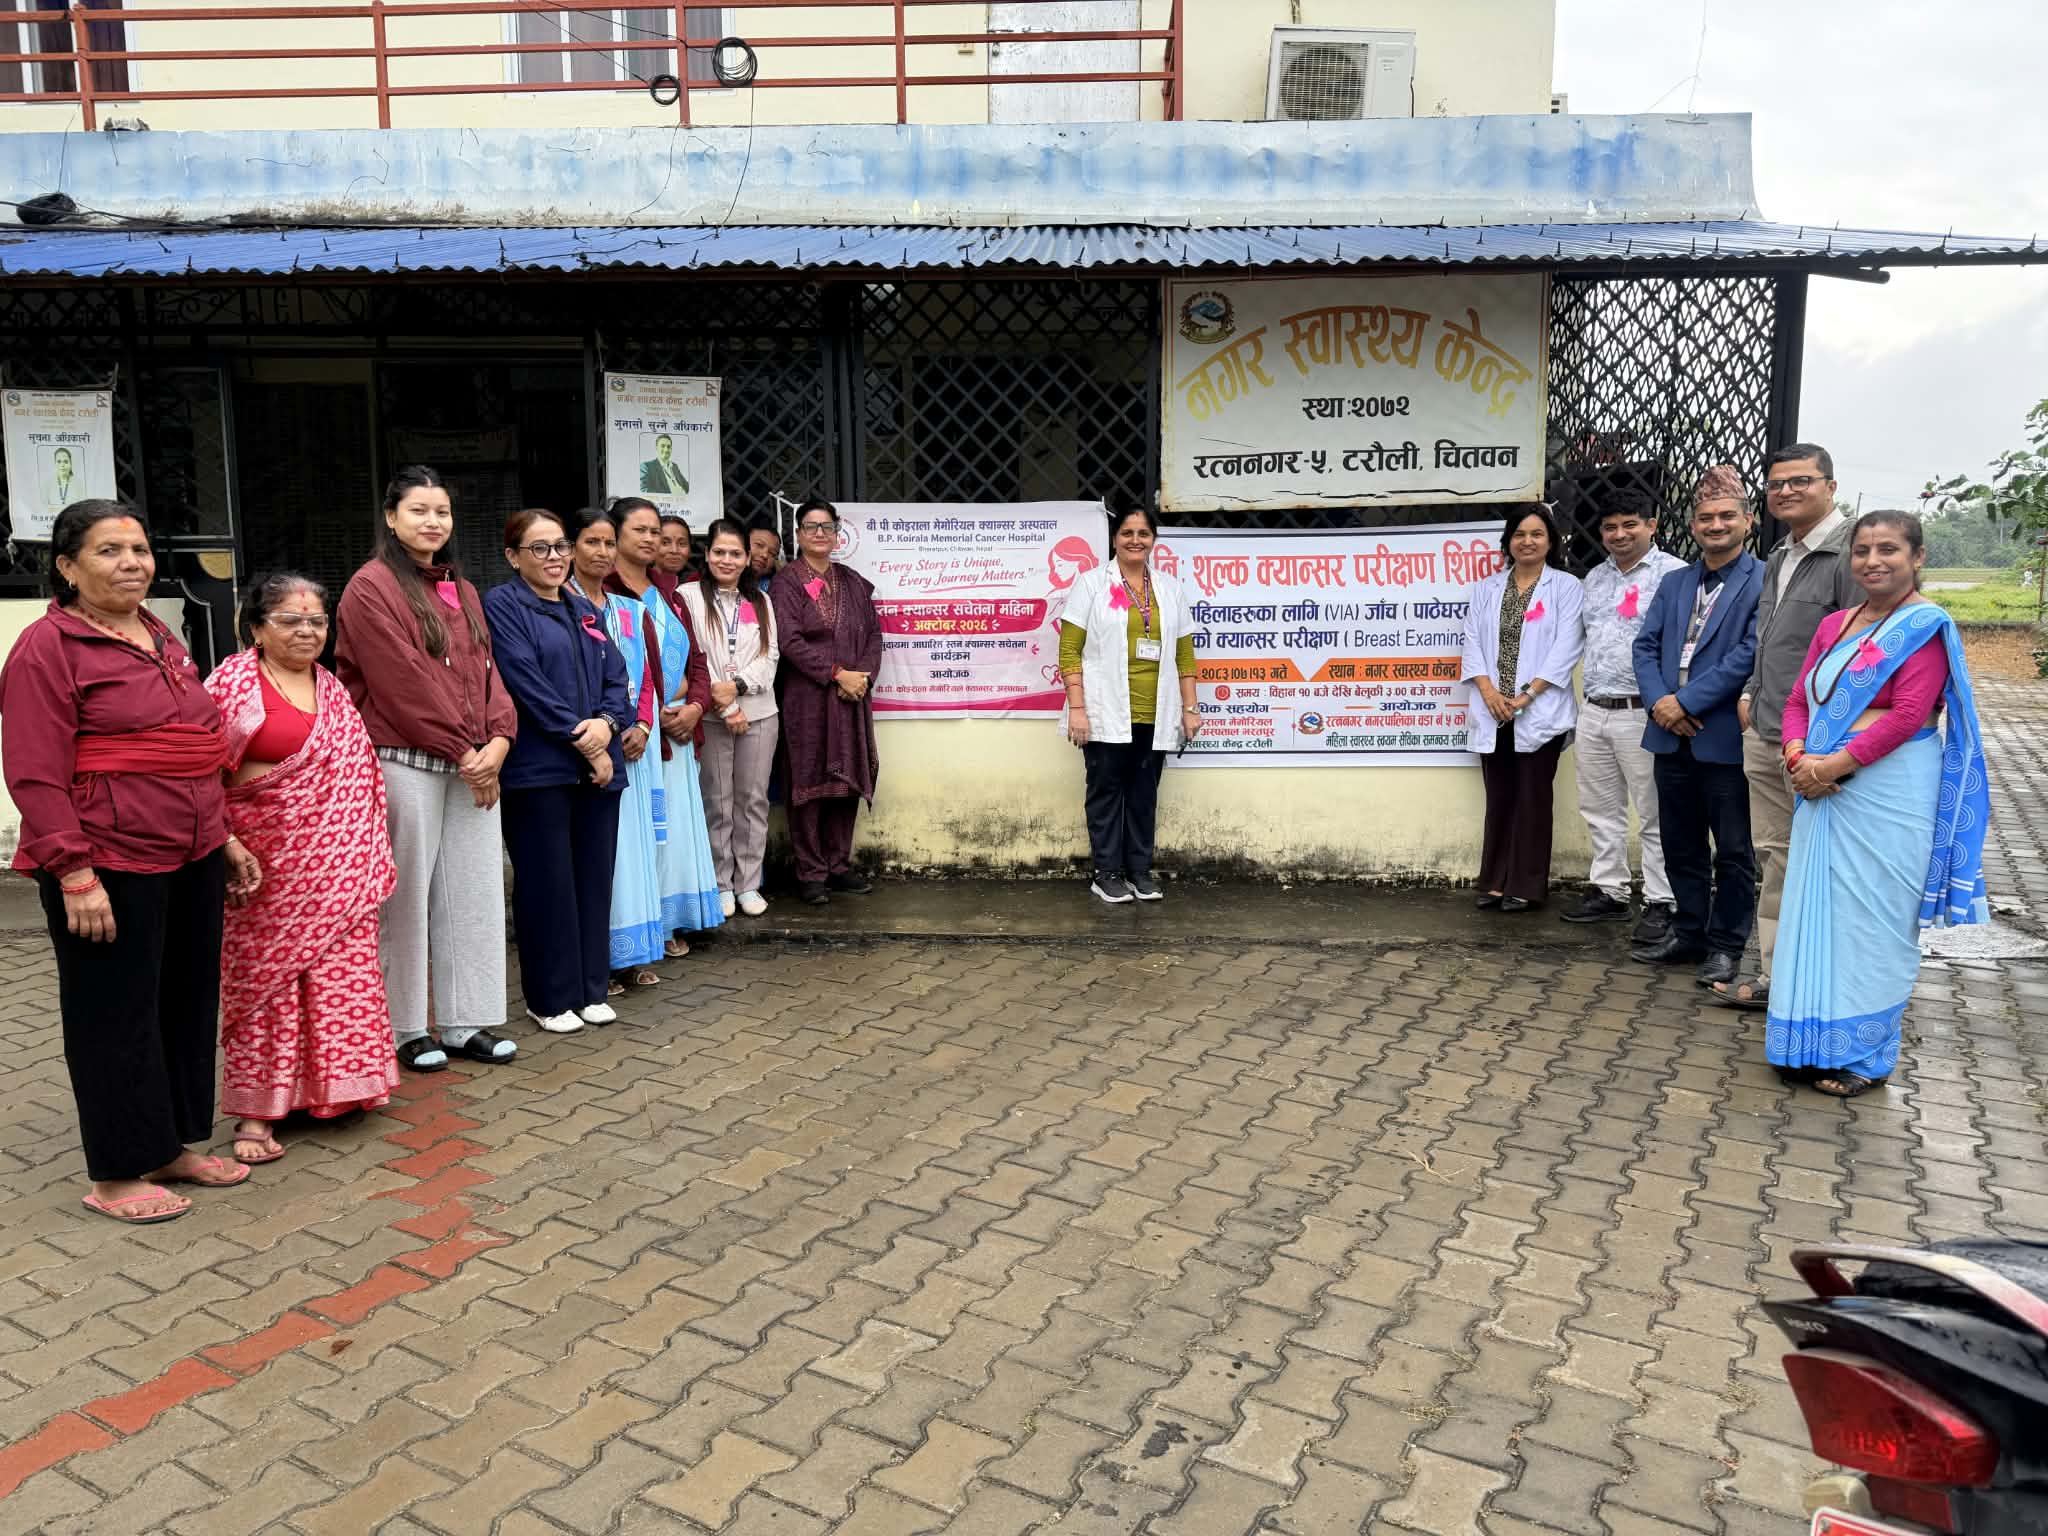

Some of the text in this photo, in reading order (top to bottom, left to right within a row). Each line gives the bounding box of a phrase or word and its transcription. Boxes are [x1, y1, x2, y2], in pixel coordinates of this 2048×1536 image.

[1176, 304, 1533, 422] नगर स्वास्थ्य केन्द्र
[672, 419, 714, 432] अधिकारी
[1342, 440, 1424, 472] टरौली,
[1433, 438, 1521, 470] चितवन
[880, 518, 889, 531] पी
[892, 518, 930, 532] कोइराला
[933, 518, 975, 531] मेमोरियल
[979, 519, 1015, 531] क्यान्सर
[1019, 519, 1057, 531] अस्पताल
[878, 533, 1046, 544] B.P. Koirala Memorial Cancer Hospital
[915, 559, 948, 572] Story
[950, 558, 960, 569] is
[1256, 554, 1346, 588] क्यान्सर
[1353, 543, 1436, 588] परीक्षण
[898, 573, 932, 587] Every
[936, 571, 980, 586] Journey
[902, 603, 949, 617] क्यान्सर
[953, 601, 995, 617] सचेतना
[999, 599, 1035, 616] महिना
[1281, 598, 1320, 622] लागि
[1325, 602, 1359, 621] (VIA)
[1364, 598, 1399, 621] जाँच
[913, 617, 956, 632] अक्टोबर
[912, 638, 943, 649] आधारित
[946, 640, 963, 649] स्तन
[965, 639, 995, 649] क्यान्सर
[997, 638, 1027, 649] सचेतना
[1216, 631, 1278, 650] क्यान्सर
[1283, 625, 1339, 650] परीक्षण
[1354, 629, 1401, 648] Breast
[930, 649, 971, 662] कार्यक्रम
[930, 667, 970, 679] आयोजक
[1270, 664, 1288, 680] गते
[1328, 663, 1355, 679] स्थान
[1365, 663, 1389, 679] नगर
[1392, 662, 1430, 679] स्वास्थ्य
[1432, 659, 1457, 679] केन्द्र
[1235, 688, 1260, 698] समय
[1299, 688, 1310, 697] १०
[1314, 683, 1329, 697] बजे
[1332, 684, 1352, 698] देखि
[1410, 684, 1426, 697] बजे
[1429, 686, 1452, 697] सम्म
[1226, 702, 1270, 715] सहयोग
[1379, 700, 1438, 712] आयोजक
[1229, 716, 1273, 727] मेमोरियल
[1325, 714, 1363, 728] रत्ननगर
[1365, 711, 1416, 728] नगरपालिका
[1418, 714, 1433, 727] वडा
[1453, 711, 1467, 727] को
[1200, 728, 1239, 738] अस्पताल
[1325, 732, 1348, 748] महिला
[1246, 738, 1273, 749] टरौली
